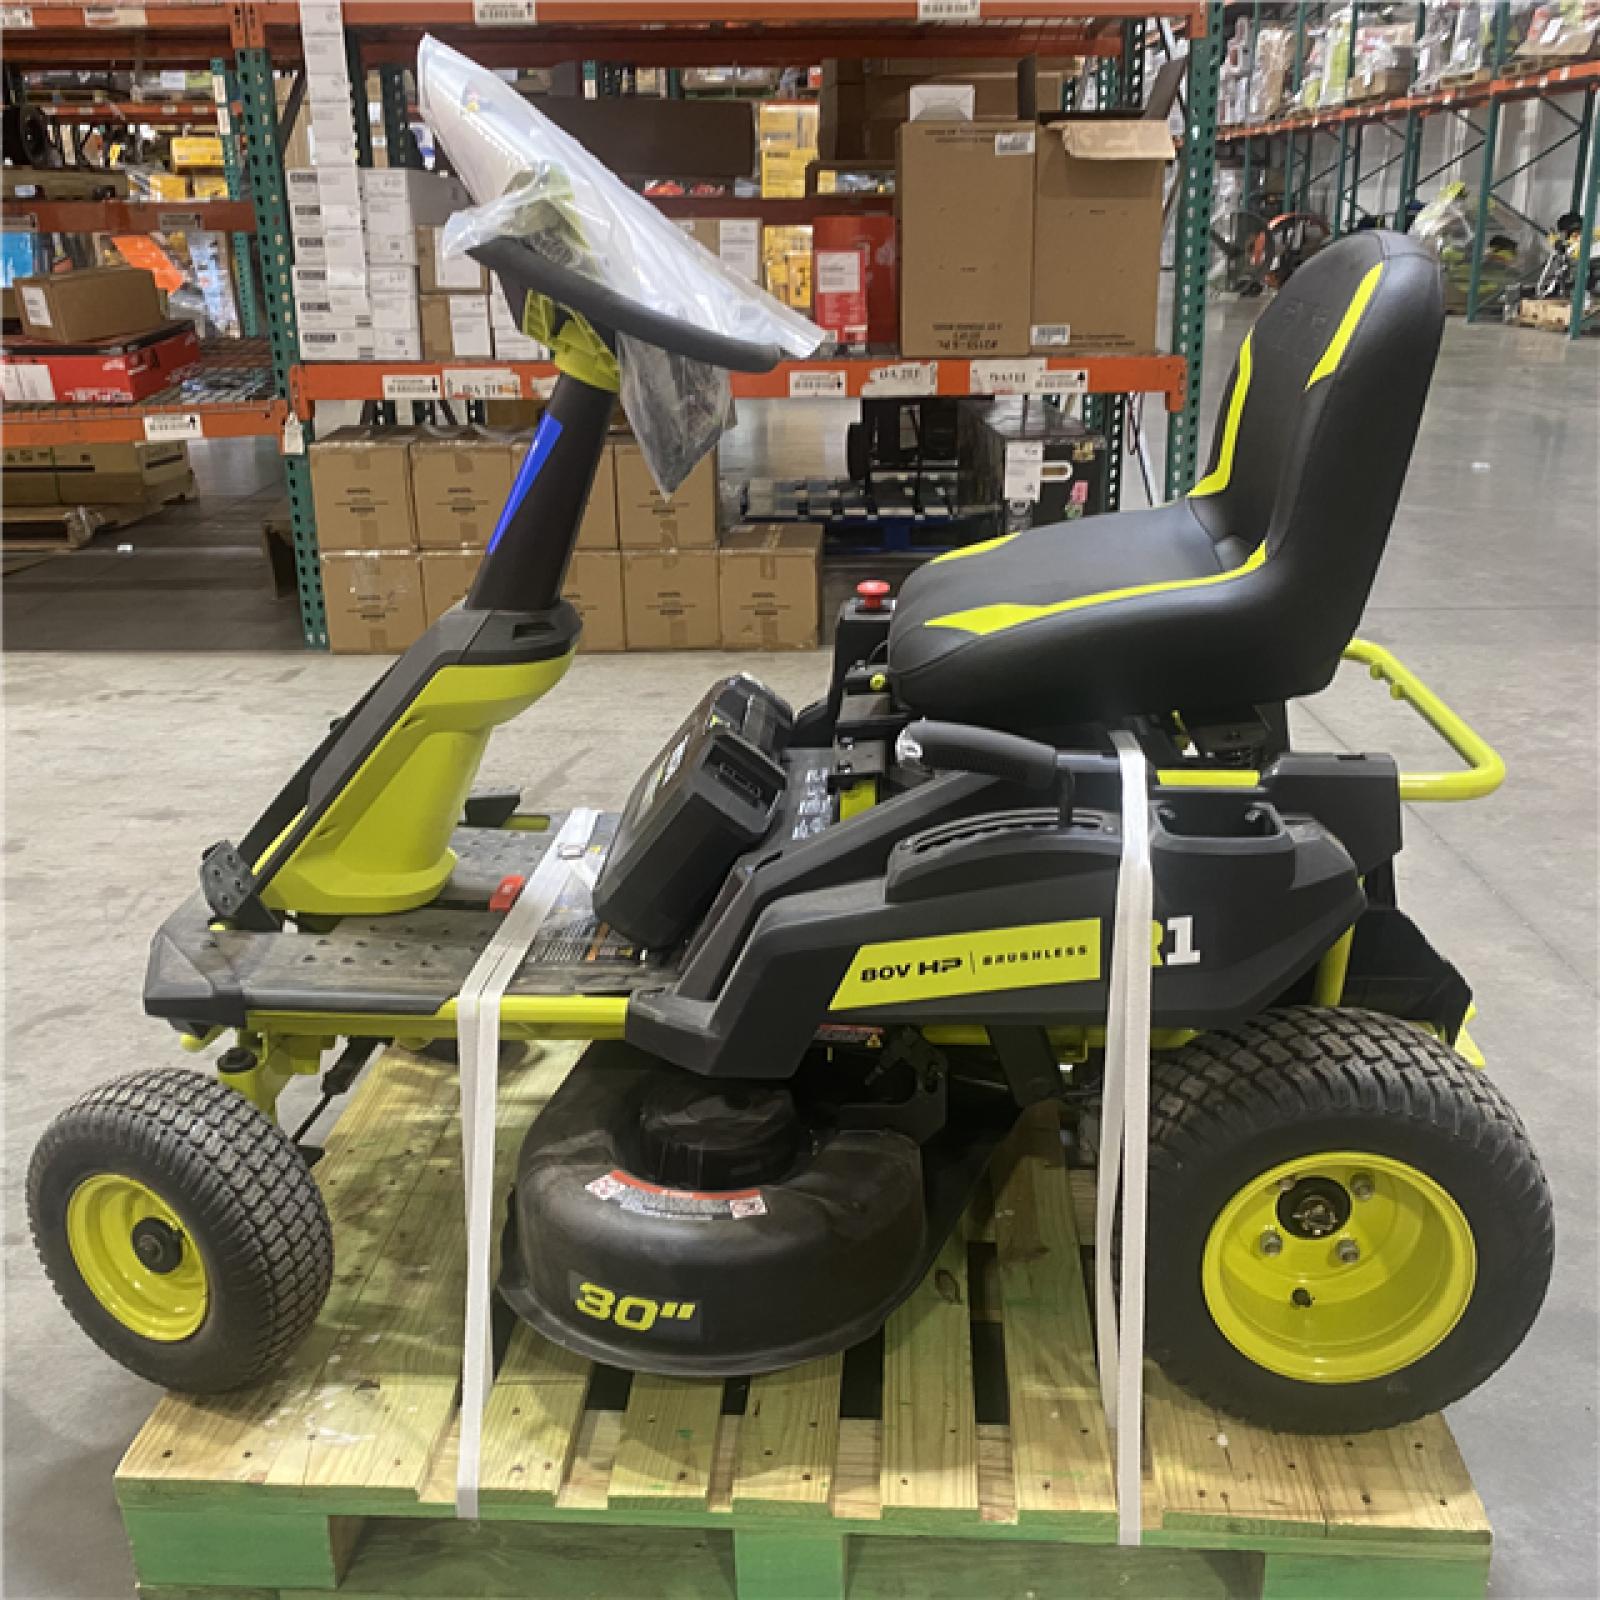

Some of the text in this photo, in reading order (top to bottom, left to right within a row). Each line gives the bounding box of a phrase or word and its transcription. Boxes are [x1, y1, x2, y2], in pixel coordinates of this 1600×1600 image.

[860, 945, 1088, 982] 80V HP BRUSHLESS
[575, 1282, 696, 1331] 30"
